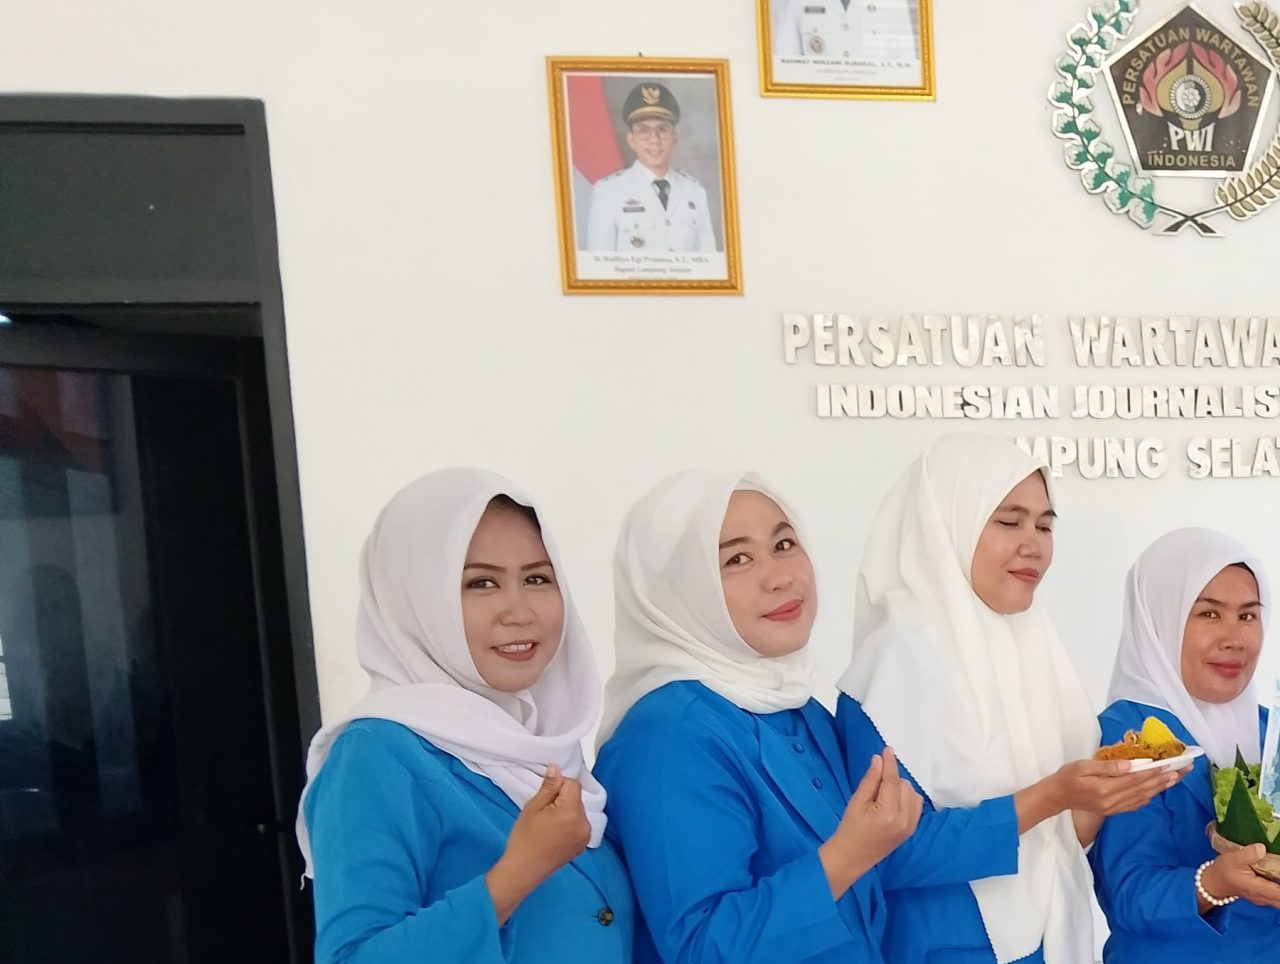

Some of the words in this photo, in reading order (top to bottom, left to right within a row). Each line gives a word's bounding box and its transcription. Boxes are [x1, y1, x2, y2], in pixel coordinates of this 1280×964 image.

[1122, 27, 1191, 106] PERSATUAN
[1195, 27, 1261, 107] WARTAWAN
[1167, 121, 1215, 152] PWI
[1147, 153, 1236, 168] INDONESIA
[782, 312, 1046, 368] PERSATUAN
[816, 384, 1059, 419] INDONESIAN
[1015, 435, 1169, 479] MPUNG
